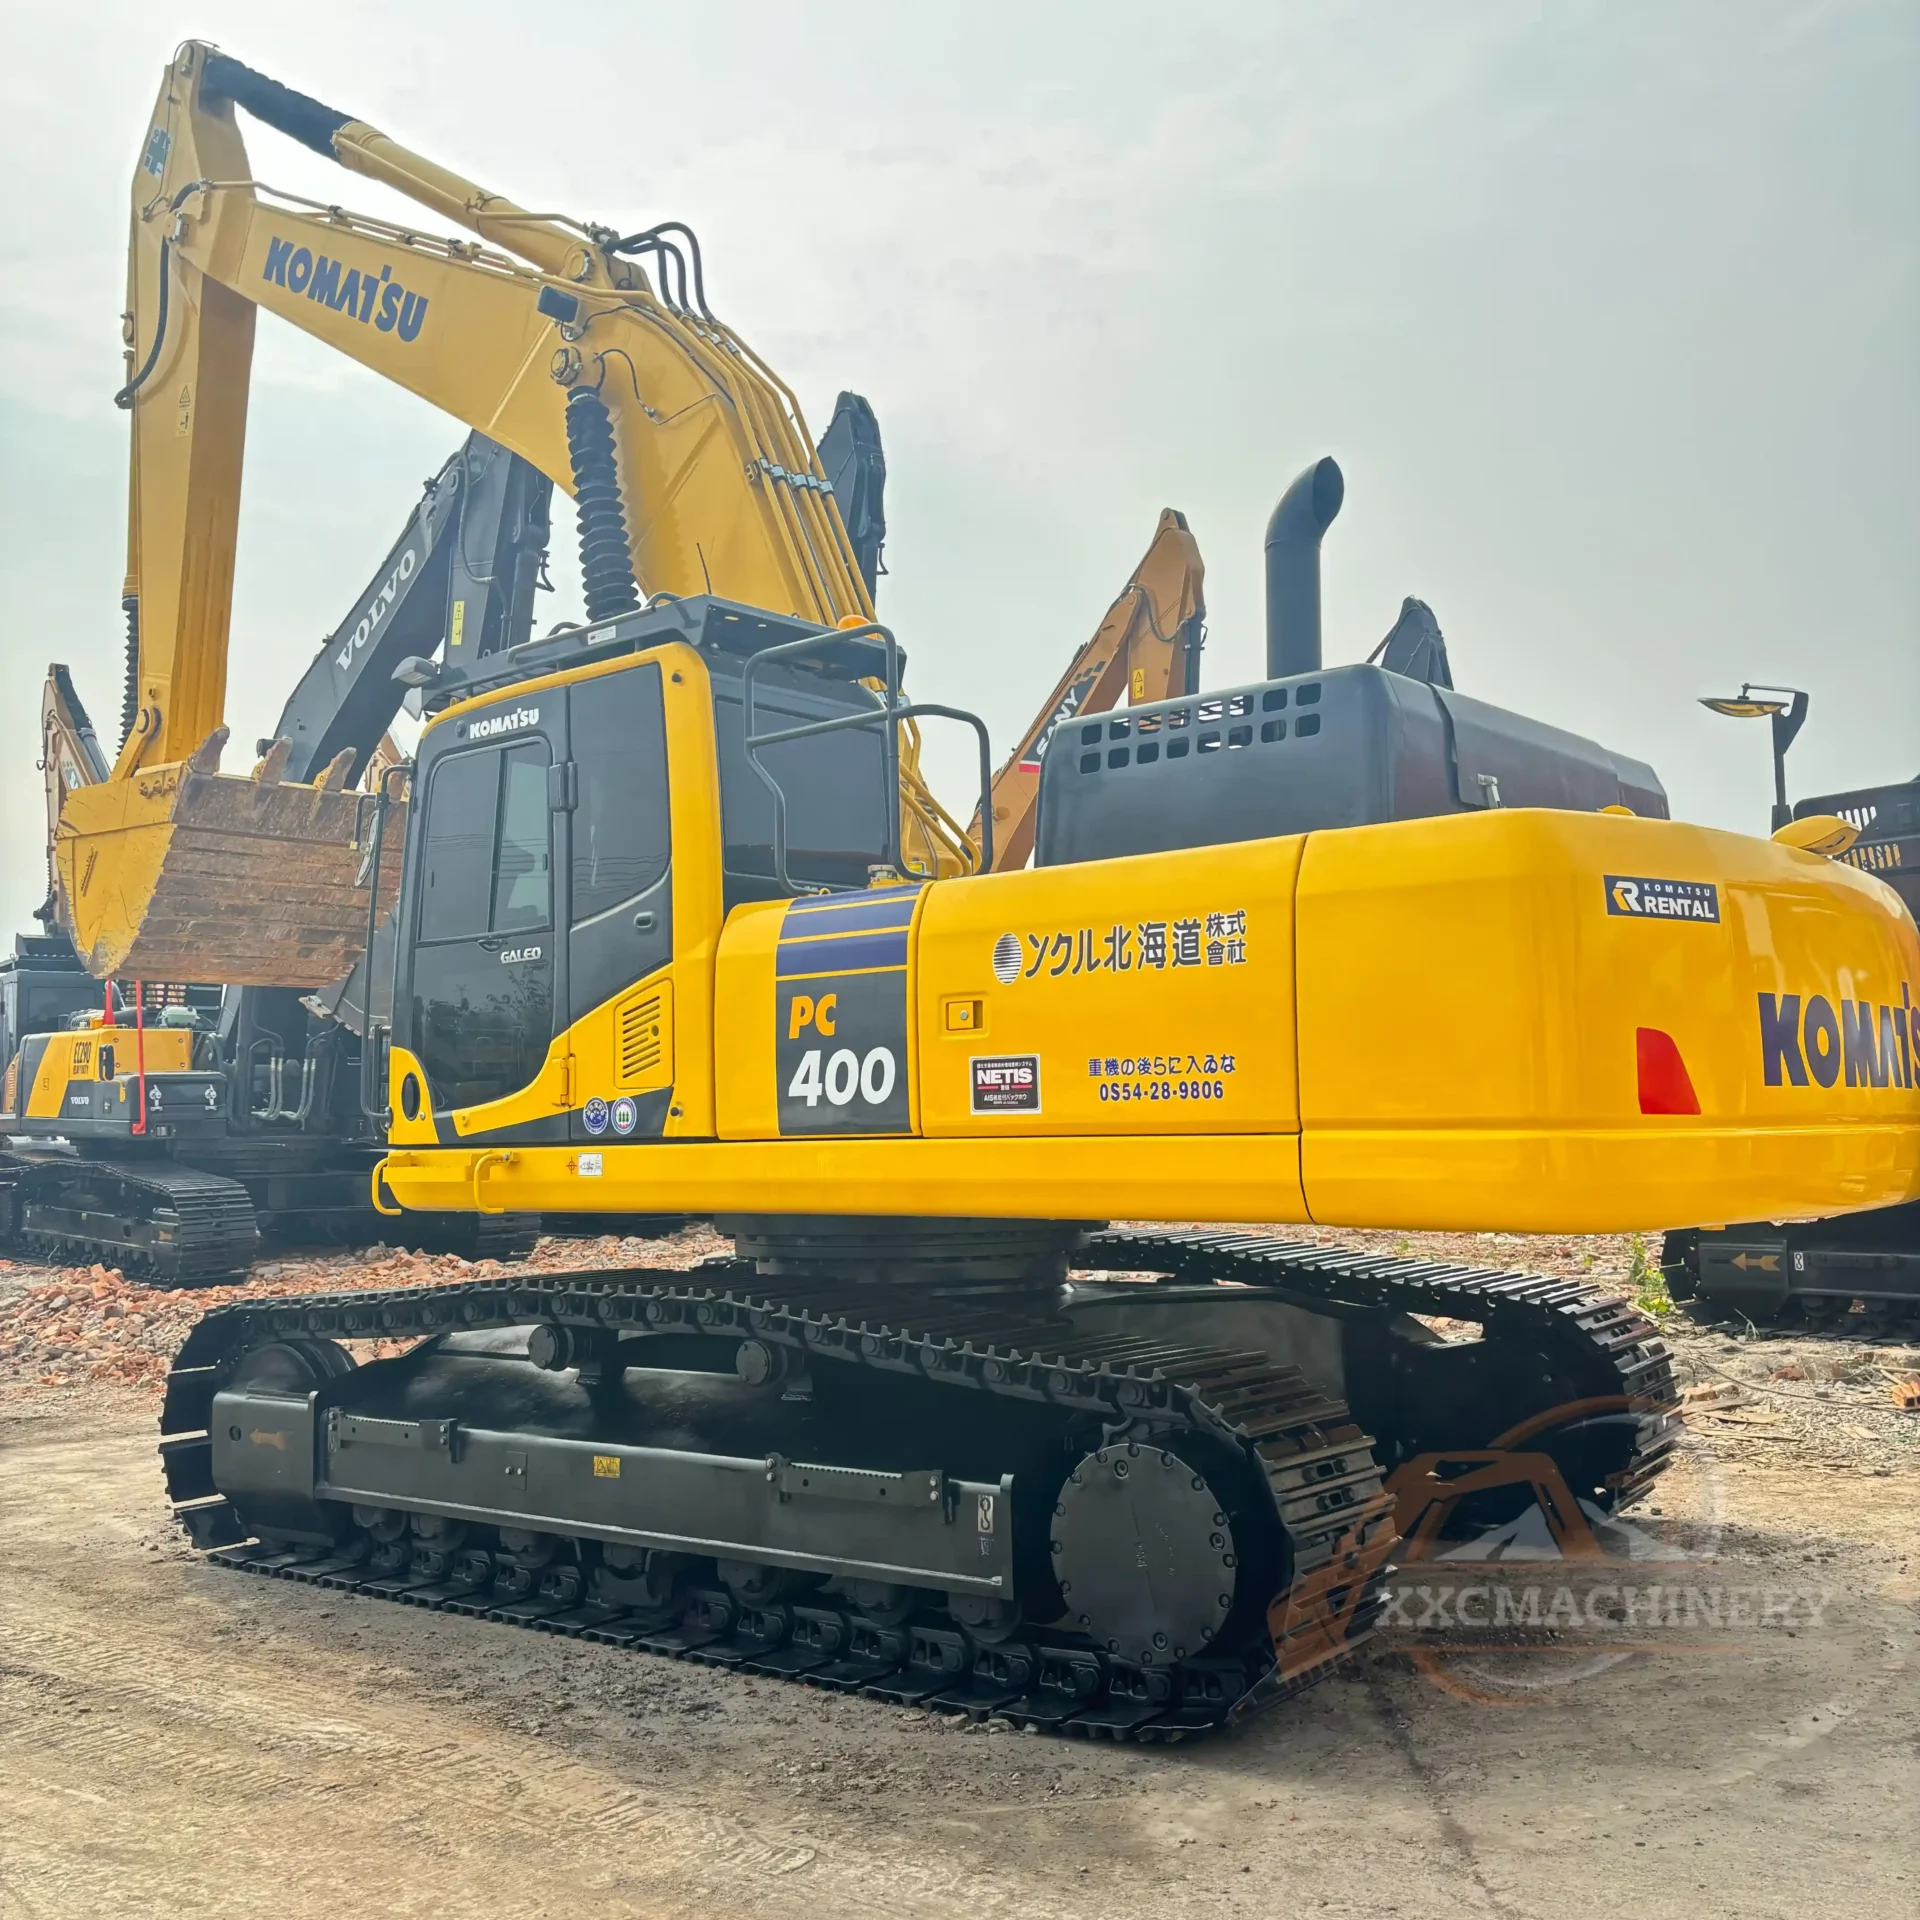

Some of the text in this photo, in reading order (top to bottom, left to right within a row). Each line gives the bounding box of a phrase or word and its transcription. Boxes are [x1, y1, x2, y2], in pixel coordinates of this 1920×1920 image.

[262, 236, 429, 342] KOMATSU
[335, 548, 415, 670] VOLVO
[470, 708, 540, 739] KOMATSU
[1644, 883, 1710, 897] KOMATSU
[1644, 896, 1715, 918] RENTAL
[501, 947, 542, 964] GALEO
[788, 993, 837, 1039] PC
[788, 1046, 896, 1107] 400
[976, 1068, 1033, 1085] NETIS
[70, 1096, 90, 1105] VOLVO
